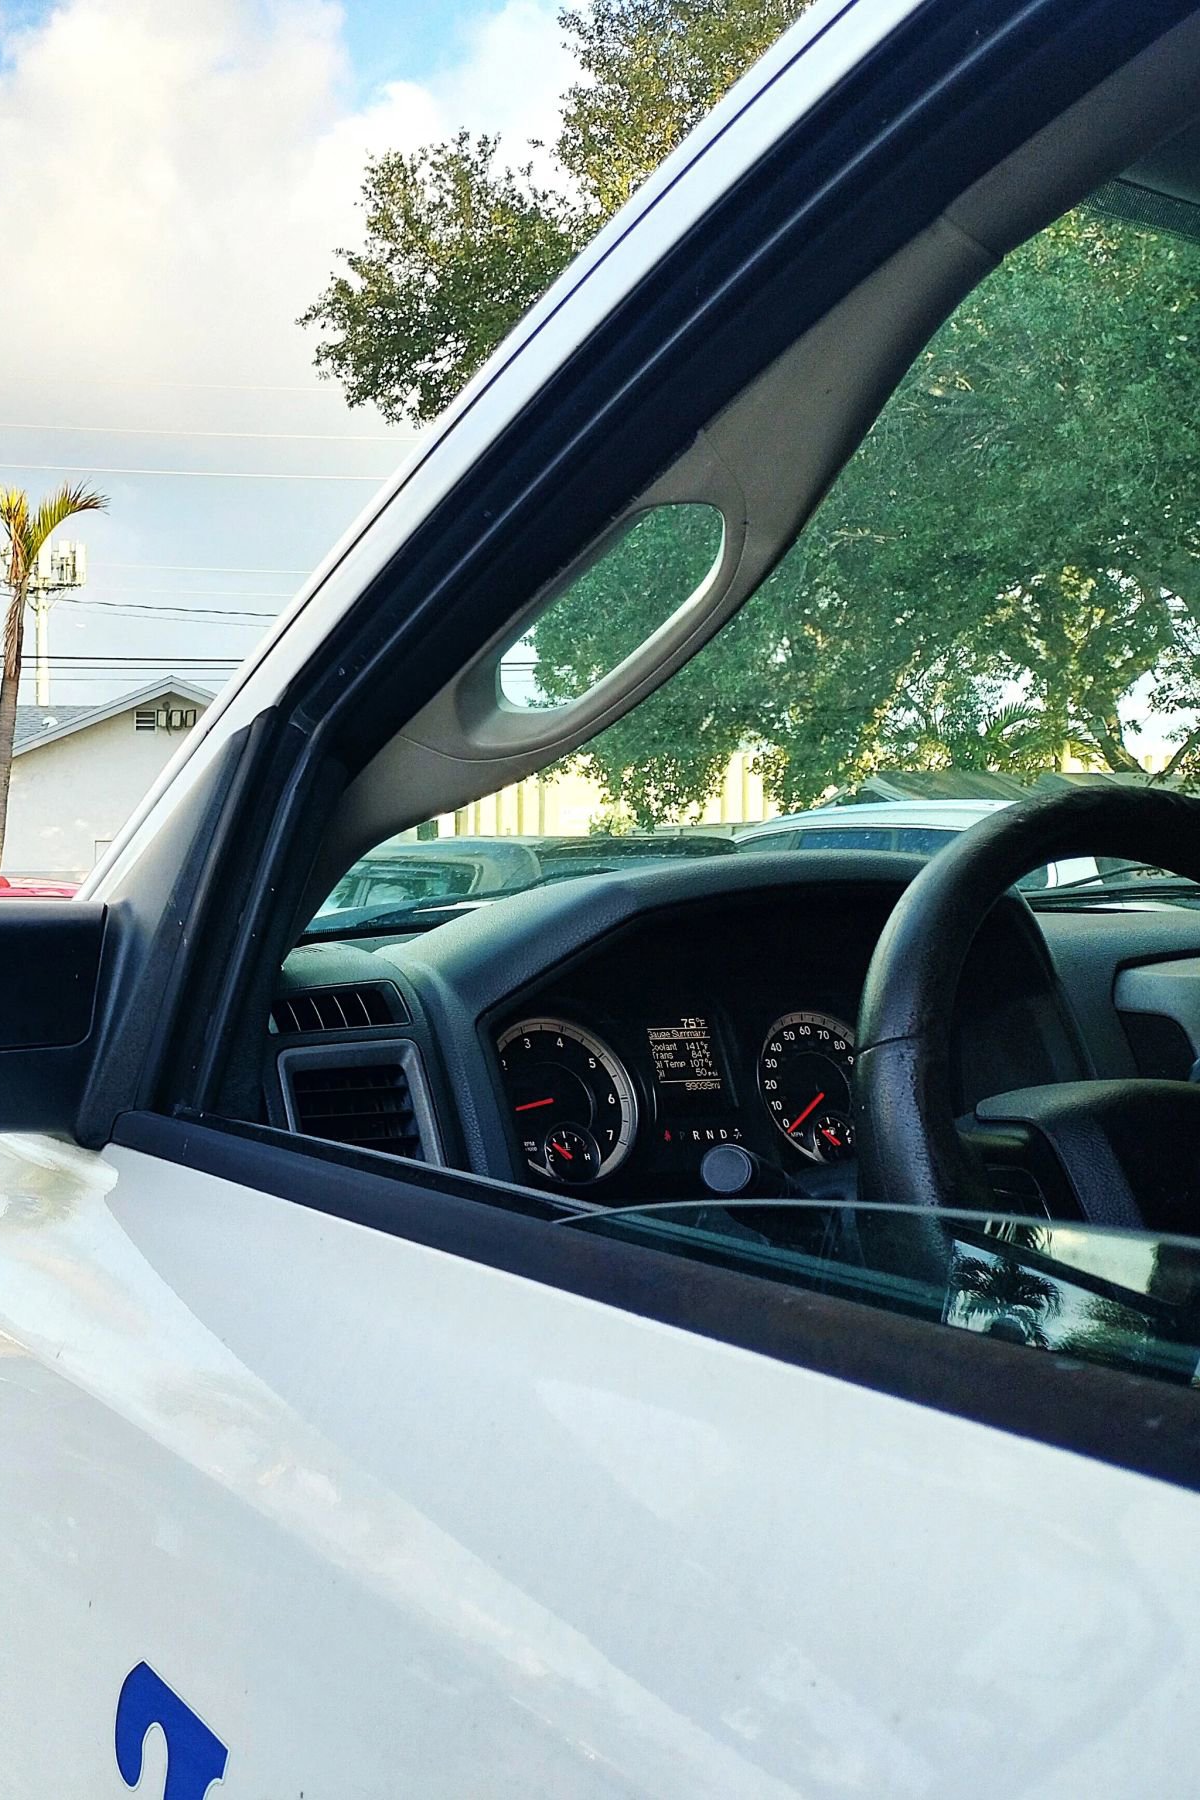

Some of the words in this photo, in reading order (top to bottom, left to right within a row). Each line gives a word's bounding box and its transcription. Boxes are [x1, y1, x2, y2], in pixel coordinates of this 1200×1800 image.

[671, 1029, 706, 1038] Summary
[799, 1025, 811, 1036] 60
[817, 1030, 830, 1040] 70
[783, 1031, 795, 1041] 50
[523, 1038, 531, 1049] 3
[556, 1037, 564, 1048] 4
[770, 1042, 782, 1052] 40
[834, 1040, 846, 1050] 80
[652, 1051, 674, 1060] Trans
[847, 1055, 854, 1065] 9
[588, 1058, 597, 1069] 5
[664, 1060, 686, 1069] Temp
[765, 1059, 778, 1069] 30
[764, 1080, 778, 1090] 20
[607, 1093, 616, 1104] 6
[771, 1101, 783, 1111] 10
[782, 1118, 790, 1128] 0
[606, 1129, 614, 1141] 7
[692, 1130, 701, 1141] R
[705, 1129, 714, 1140] N
[719, 1129, 728, 1139] D
[548, 1154, 555, 1162] C
[584, 1153, 591, 1161] H
